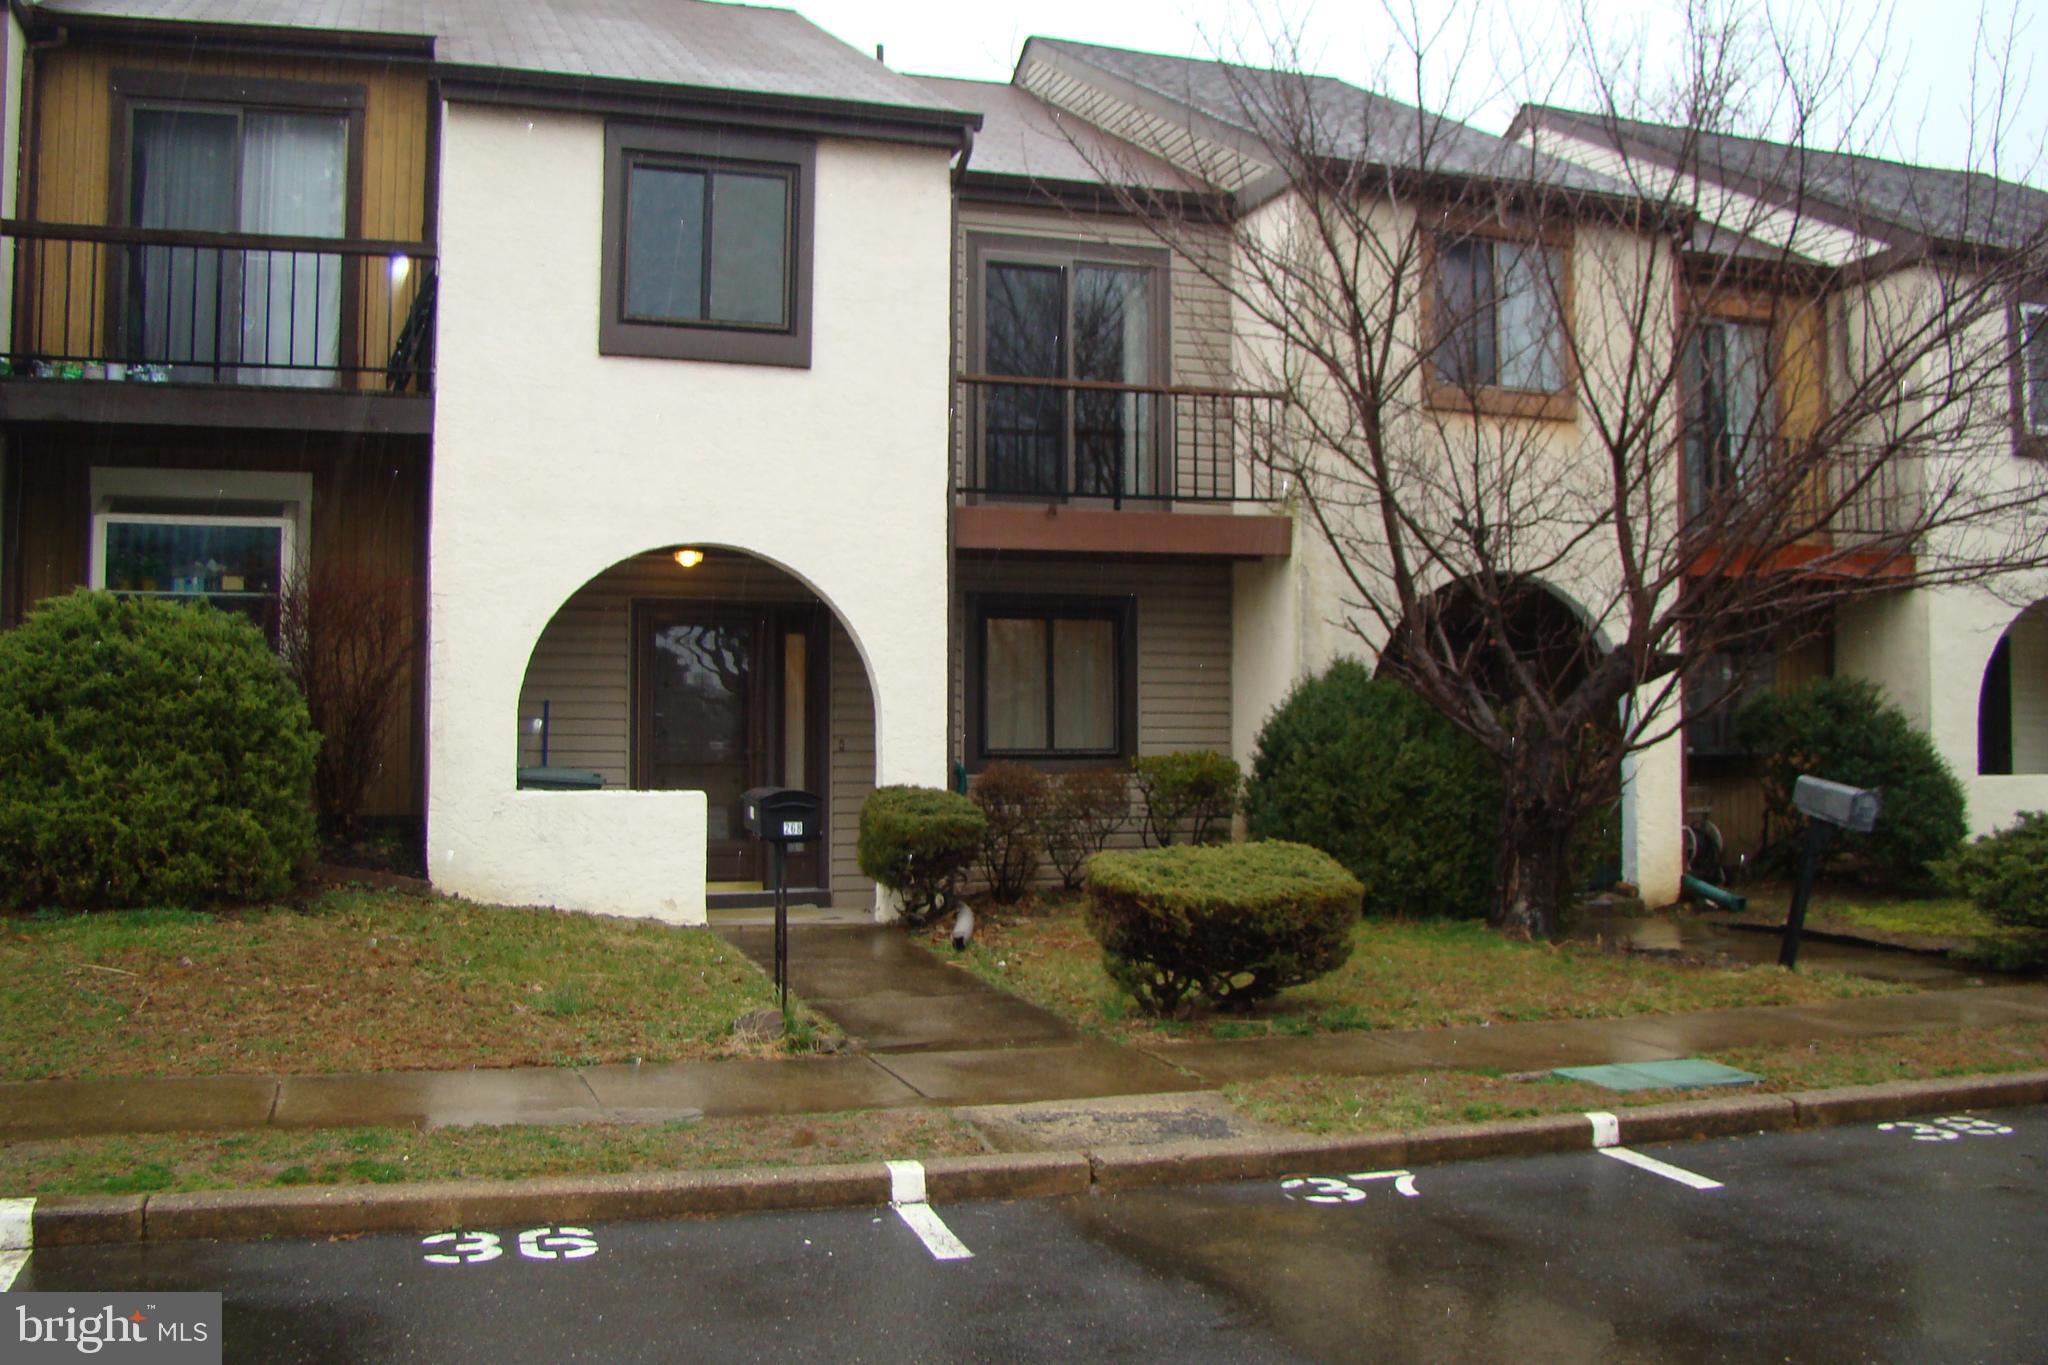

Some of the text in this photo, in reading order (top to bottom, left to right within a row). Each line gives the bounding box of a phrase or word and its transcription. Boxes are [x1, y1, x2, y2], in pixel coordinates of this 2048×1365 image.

[1877, 1116, 2013, 1141] 38
[1281, 1169, 1420, 1203] 37
[422, 1227, 599, 1263] 36
